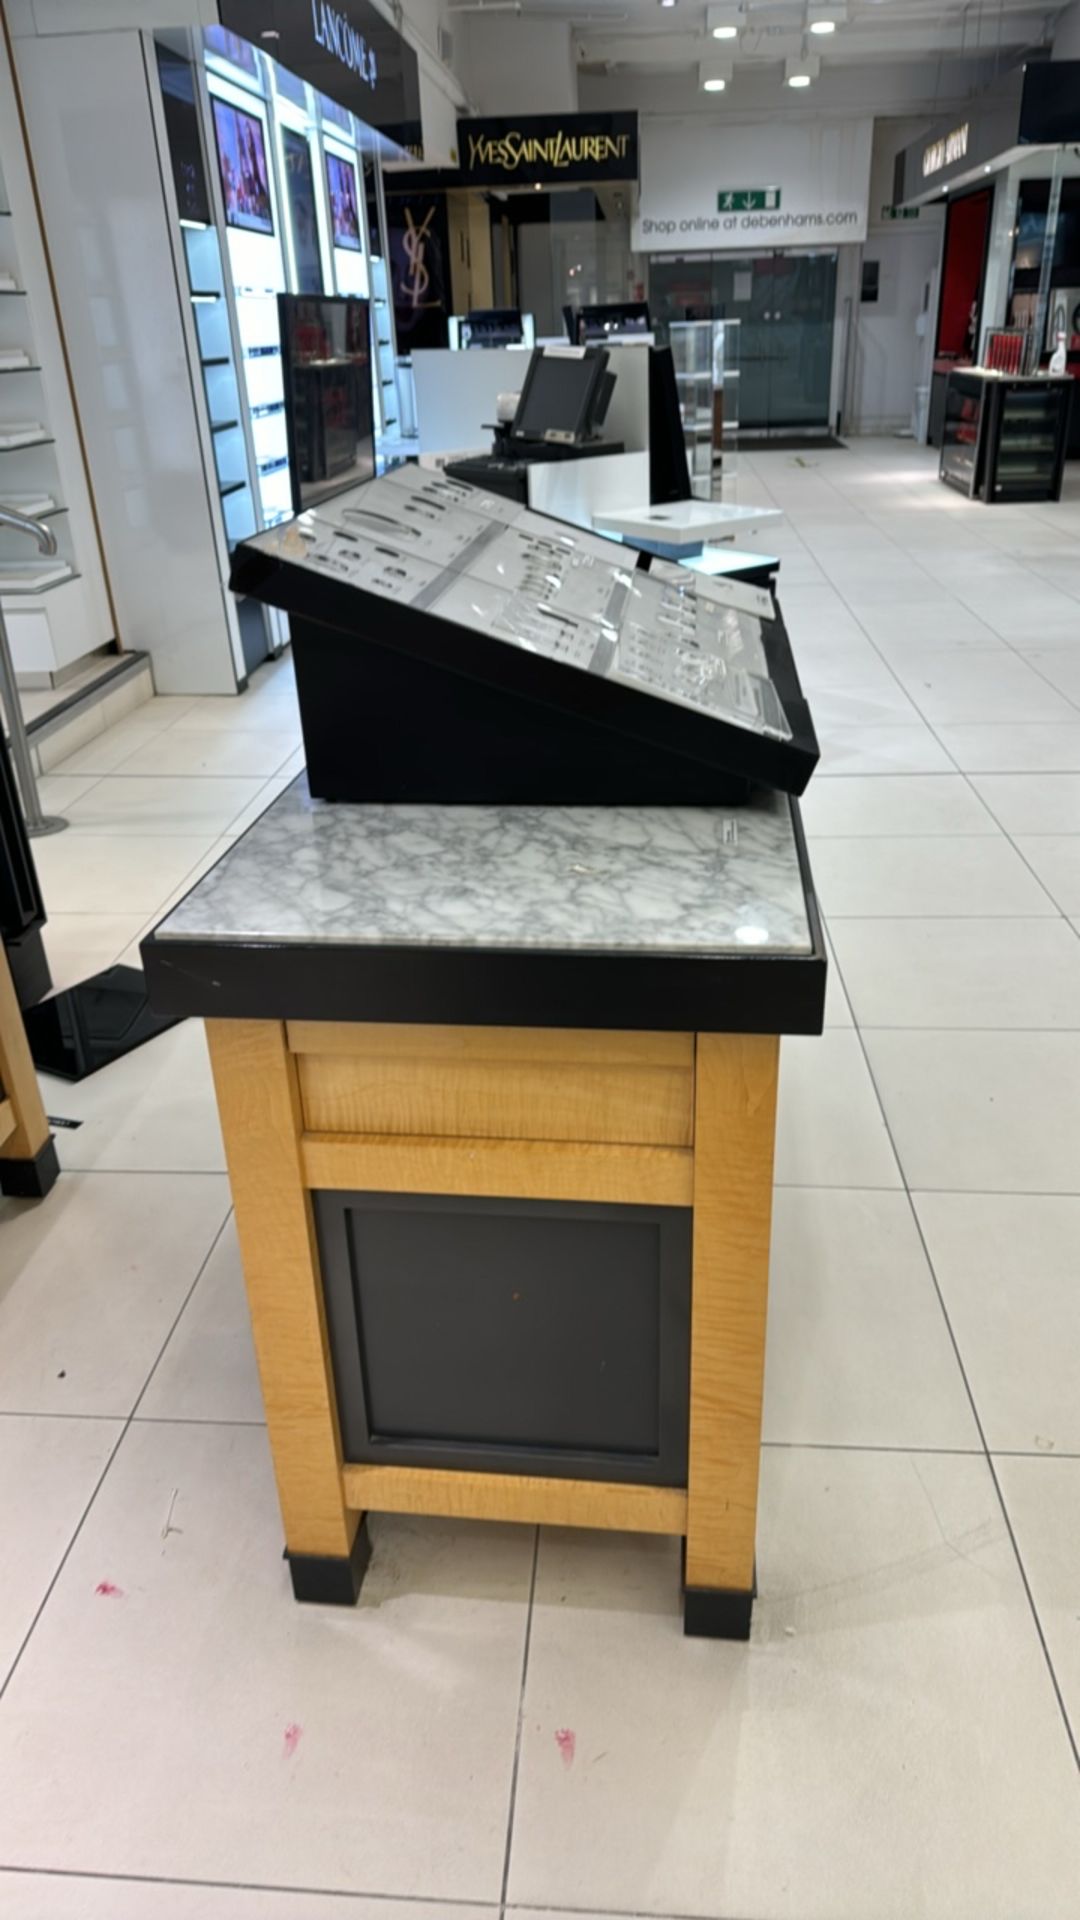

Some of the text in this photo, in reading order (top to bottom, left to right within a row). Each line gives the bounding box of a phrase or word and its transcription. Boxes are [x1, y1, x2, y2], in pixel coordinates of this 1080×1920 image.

[642, 211, 858, 235] Shop online at debenhams.com
